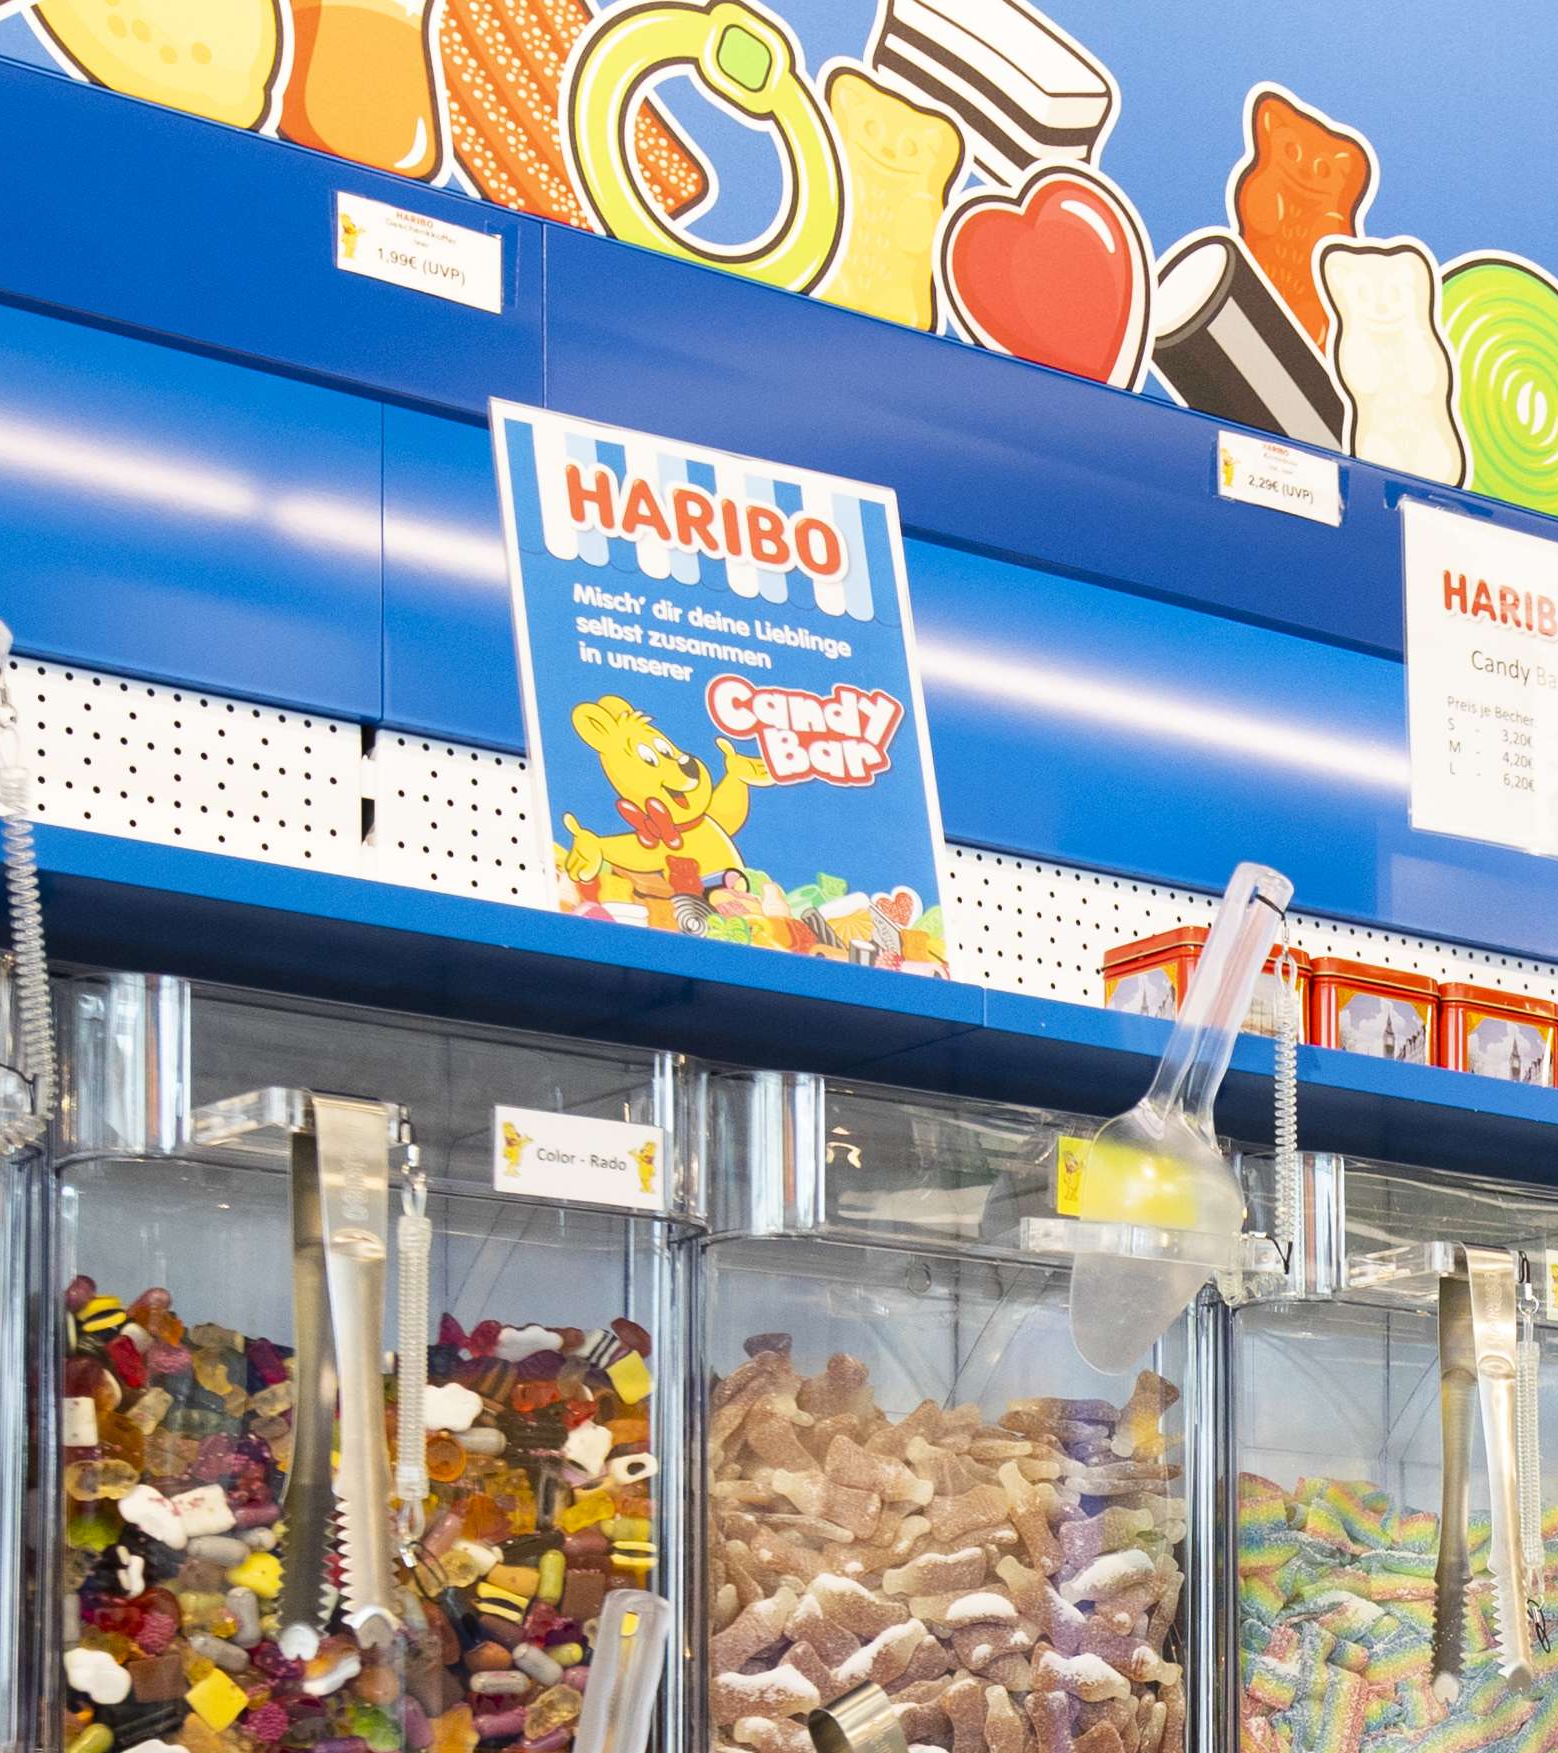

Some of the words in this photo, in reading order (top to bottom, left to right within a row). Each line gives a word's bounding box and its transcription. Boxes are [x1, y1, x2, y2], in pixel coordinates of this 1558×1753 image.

[423, 260, 465, 287] (UVP)
[565, 463, 843, 577] HARIBO
[575, 613, 643, 643] selbst
[648, 631, 772, 670] zusammen
[652, 598, 683, 624] dir
[688, 606, 750, 638] deine
[754, 619, 852, 659] Lieblinge
[579, 641, 602, 664] in
[607, 650, 693, 682] unserer
[1471, 650, 1530, 687] Candy
[713, 680, 898, 745] Candy
[1447, 695, 1477, 714] Preis
[1448, 717, 1455, 731] S
[763, 728, 882, 780] Bar
[1449, 739, 1461, 754] M
[1449, 761, 1456, 775] L
[536, 1147, 577, 1165] Color
[590, 1152, 627, 1173] Rado
